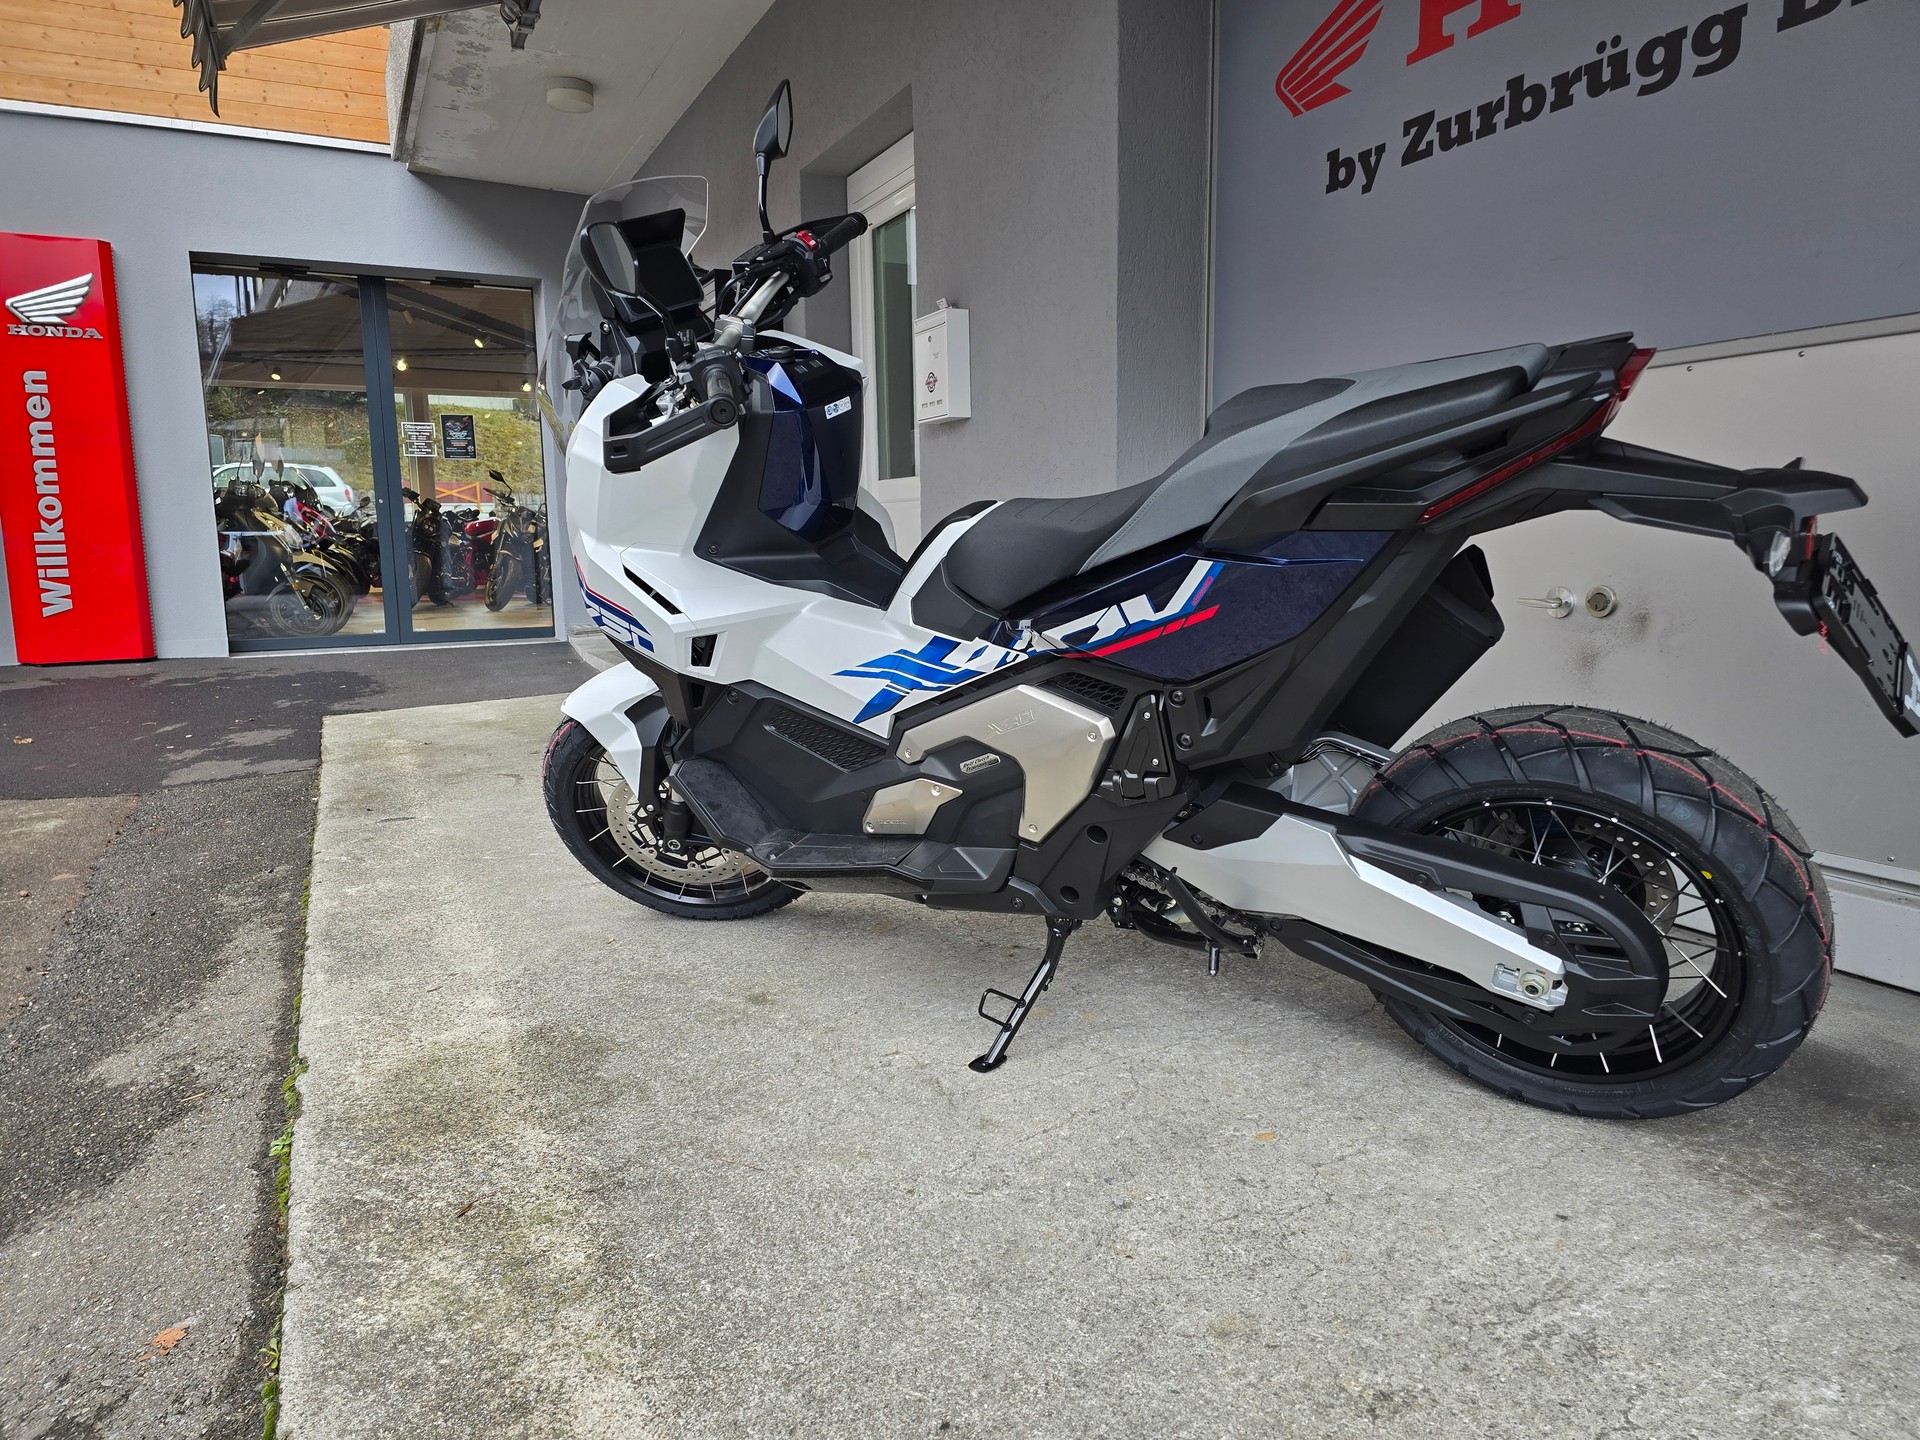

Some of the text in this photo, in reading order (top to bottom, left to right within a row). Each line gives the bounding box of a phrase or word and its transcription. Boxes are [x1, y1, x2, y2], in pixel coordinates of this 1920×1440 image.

[1325, 3, 1749, 195] by Zurbrügg
[7, 323, 103, 339] HONDA
[22, 370, 73, 618] Willkommen
